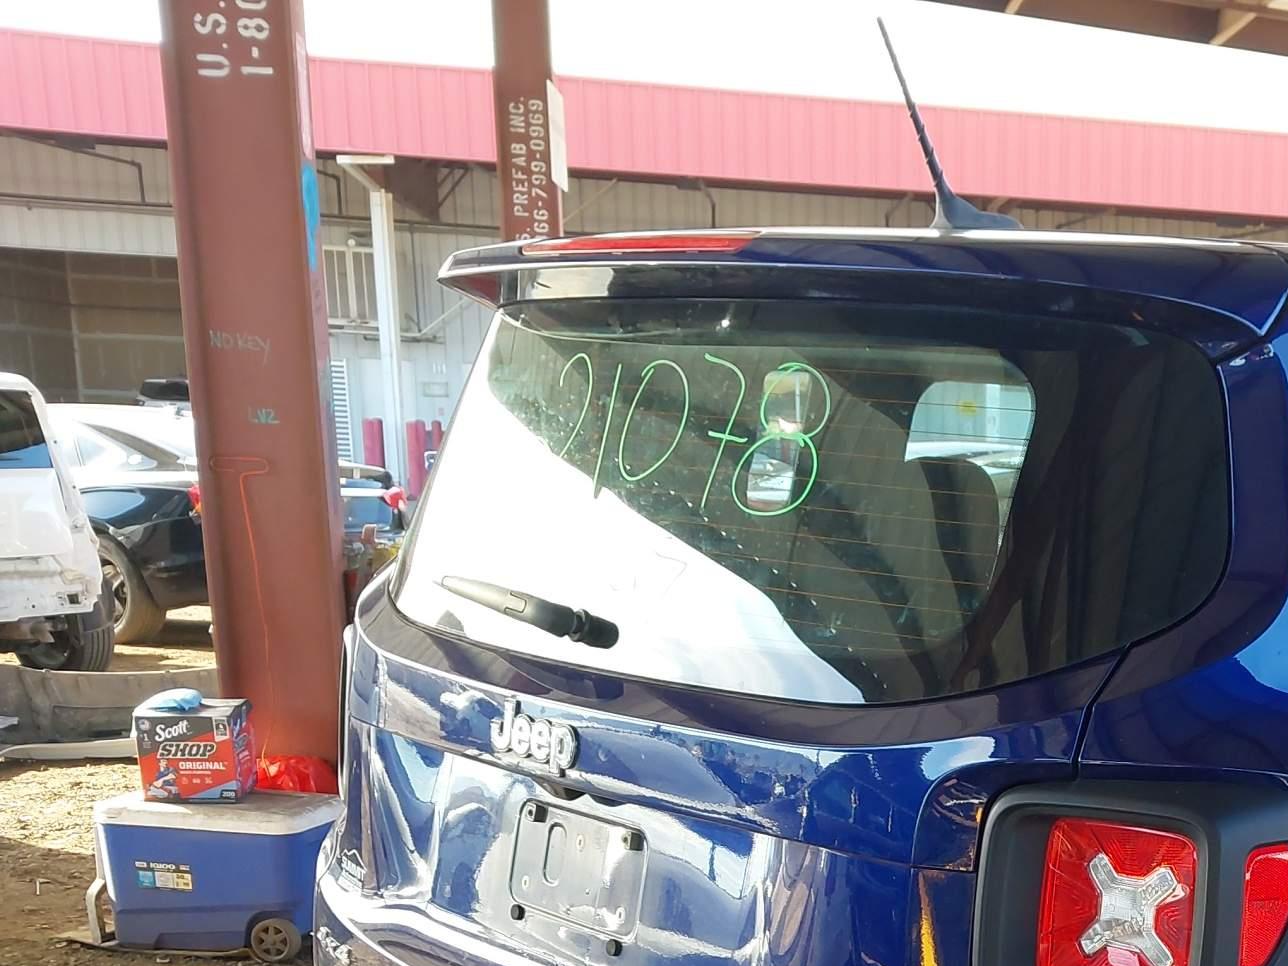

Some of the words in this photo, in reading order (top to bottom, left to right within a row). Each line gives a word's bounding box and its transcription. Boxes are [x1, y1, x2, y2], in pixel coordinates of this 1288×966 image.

[194, 2, 231, 77] U.S.
[508, 96, 526, 133] INC.
[510, 142, 530, 217] PREFAB
[558, 352, 831, 516] 21078
[155, 720, 190, 742] Scott
[156, 741, 217, 759] SHOP
[490, 696, 577, 778] Jeep
[178, 761, 227, 770] ORIGINAL
